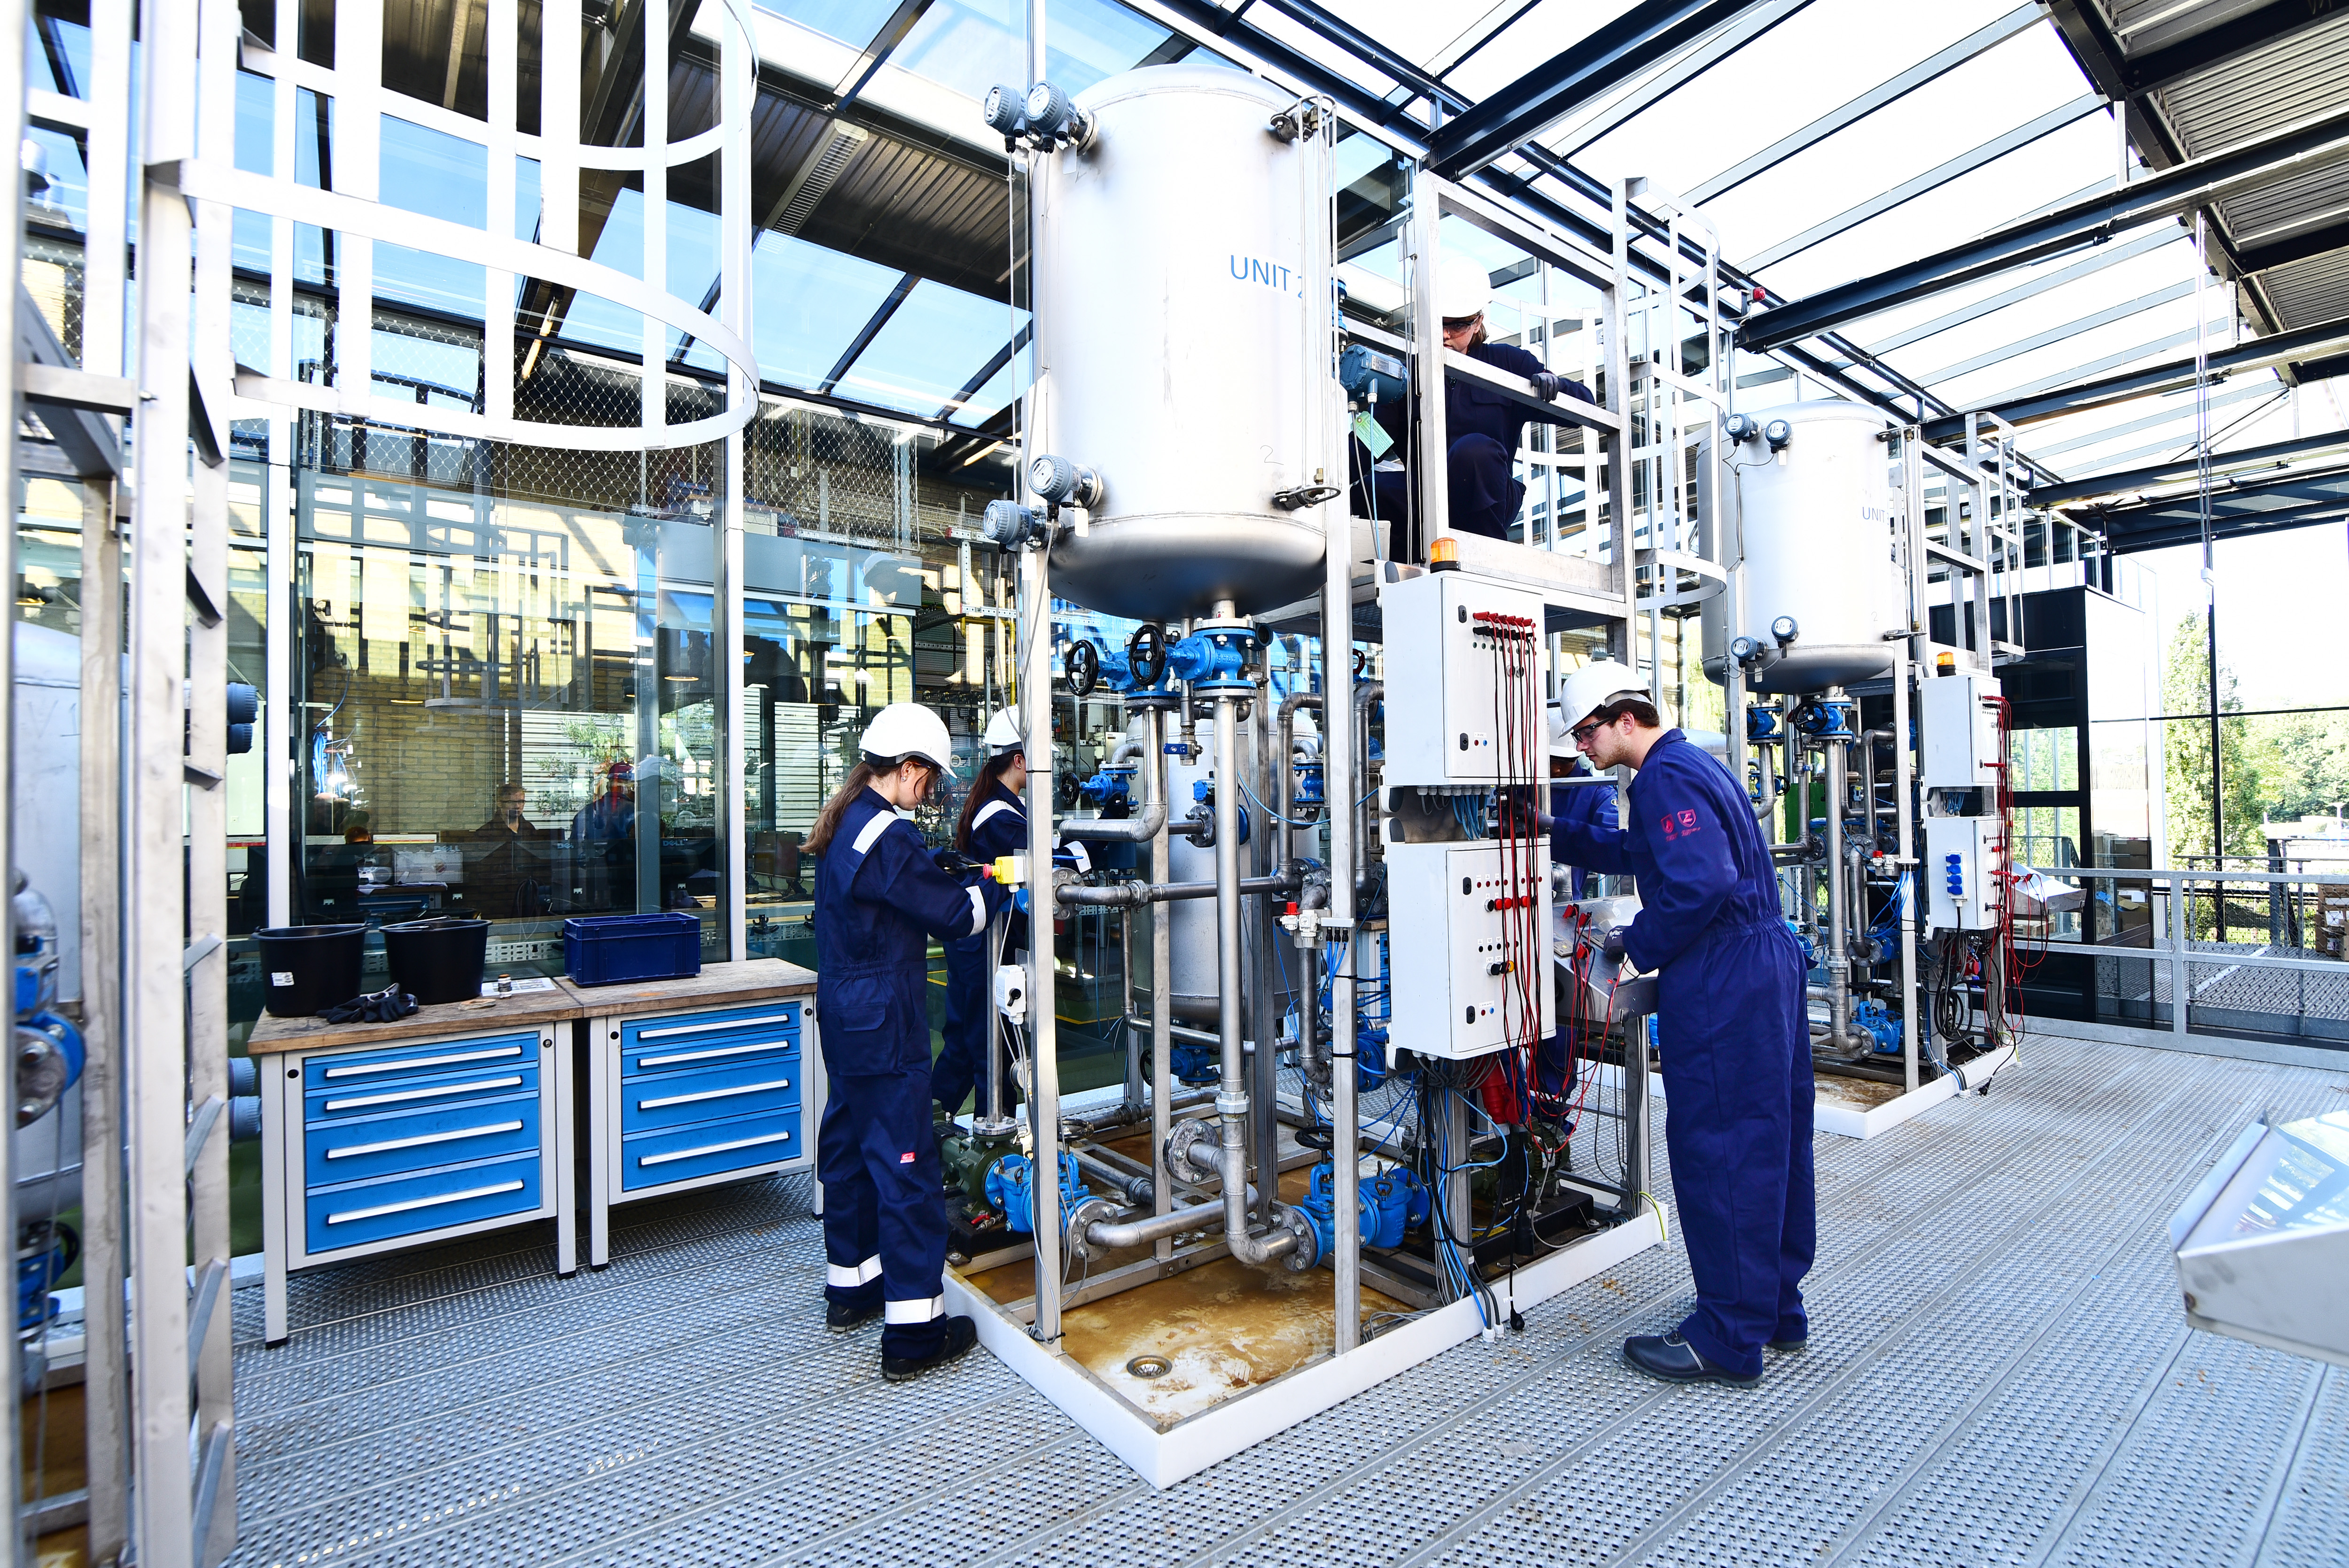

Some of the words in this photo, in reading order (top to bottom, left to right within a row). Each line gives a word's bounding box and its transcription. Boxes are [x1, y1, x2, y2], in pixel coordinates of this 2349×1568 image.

[1230, 255, 1291, 291] UNIT
[1260, 445, 1284, 466] 2
[1862, 506, 1885, 523] UNIT
[1871, 611, 1878, 621] 2
